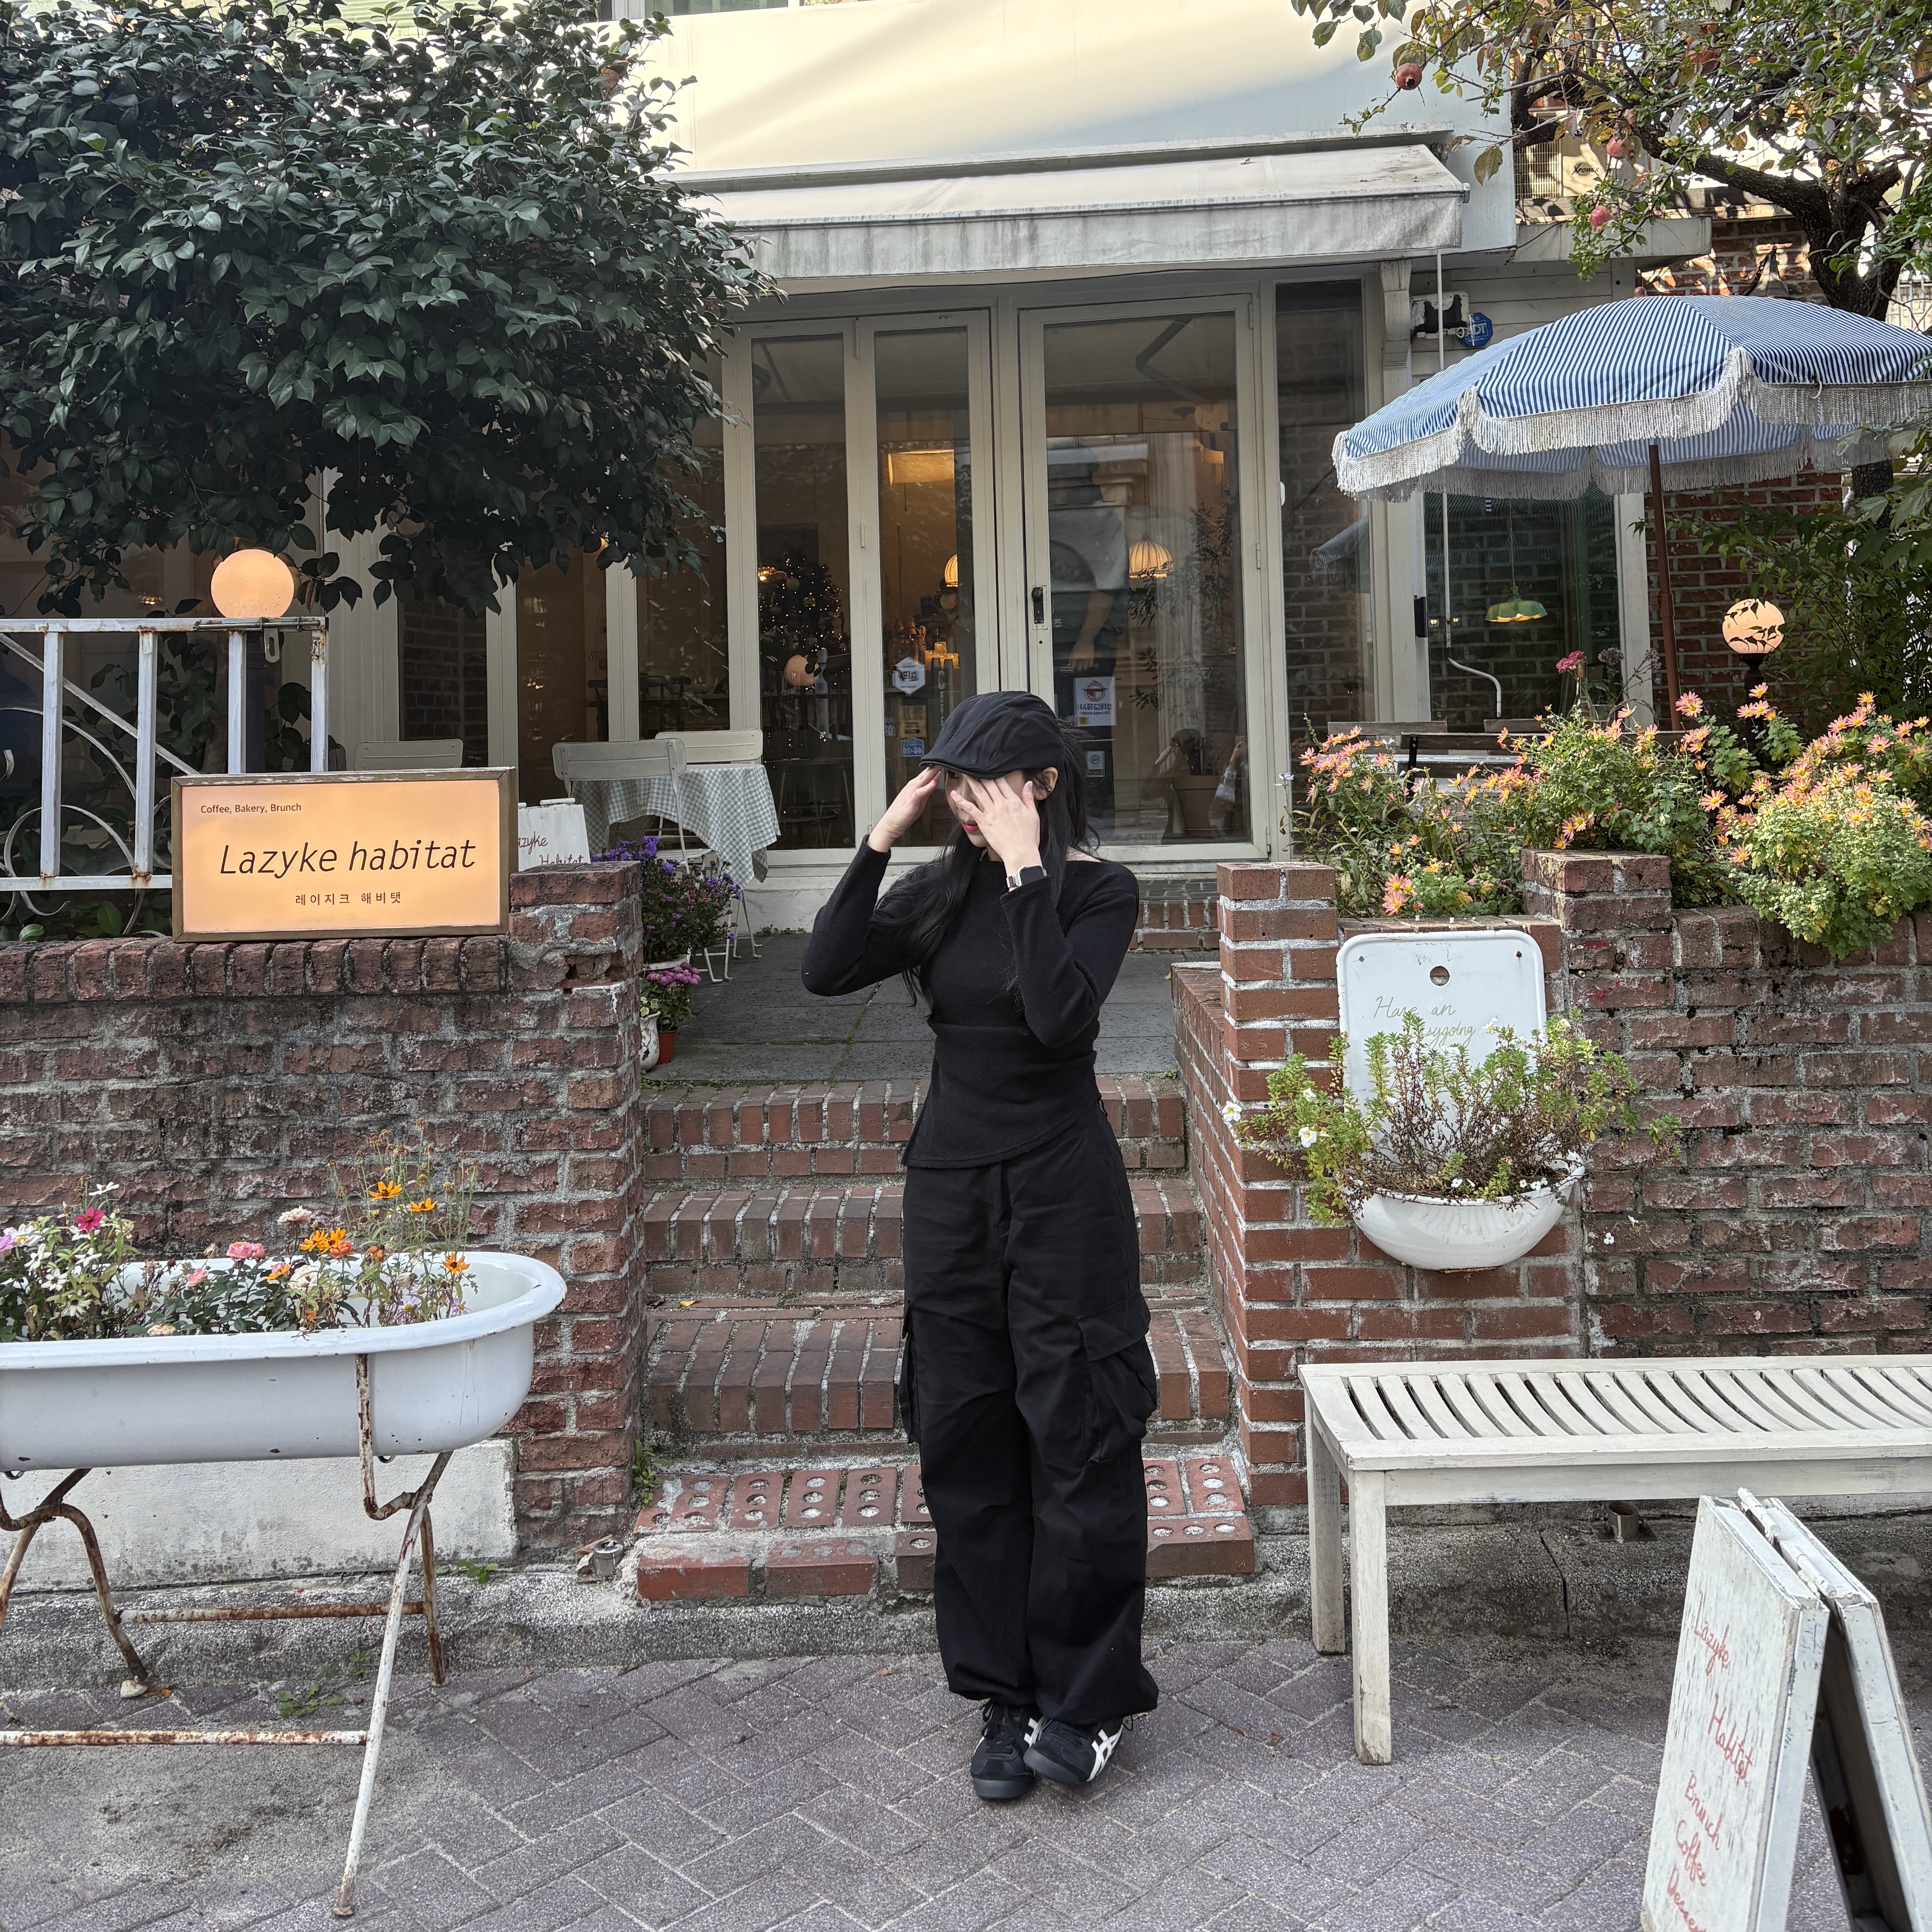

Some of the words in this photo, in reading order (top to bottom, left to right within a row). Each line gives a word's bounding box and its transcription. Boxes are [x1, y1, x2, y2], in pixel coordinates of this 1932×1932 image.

[200, 805, 232, 814] Coffee,
[235, 804, 267, 814] Bakery,
[271, 803, 301, 812] Brunch
[220, 842, 337, 879] Lazyke
[349, 839, 476, 871] habitat
[295, 893, 350, 906] 레이지크
[360, 891, 401, 905] 해비탯
[1431, 1005, 1456, 1015] an
[1693, 1591, 1729, 1676] Lazyke
[1685, 1770, 1723, 1850] Brunch
[1676, 1819, 1706, 1887] Coffee
